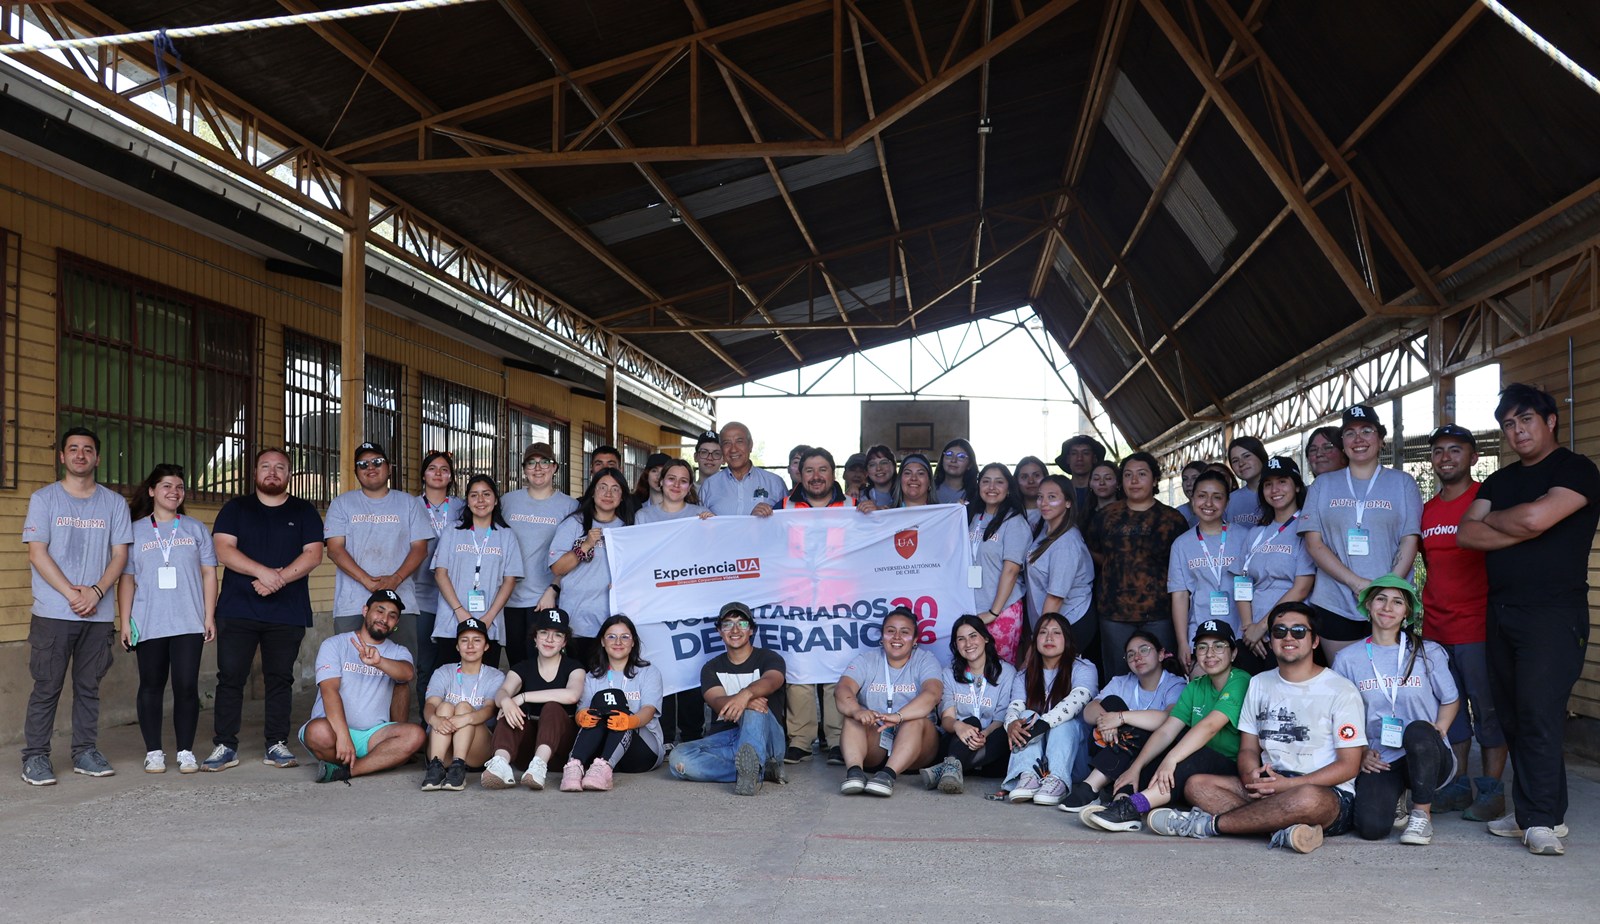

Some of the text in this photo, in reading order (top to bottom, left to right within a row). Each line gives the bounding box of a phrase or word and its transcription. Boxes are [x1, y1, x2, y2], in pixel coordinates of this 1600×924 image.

[1350, 406, 1366, 418] UA
[1329, 498, 1393, 510] AUTOMA
[141, 537, 195, 552] AUTÓOMA
[897, 538, 915, 548] UA
[874, 564, 910, 573] UNIVERSIDAD
[549, 610, 562, 623] UA
[671, 627, 726, 661] DE
[869, 682, 917, 693] AUTOMA
[603, 692, 618, 706] UA
